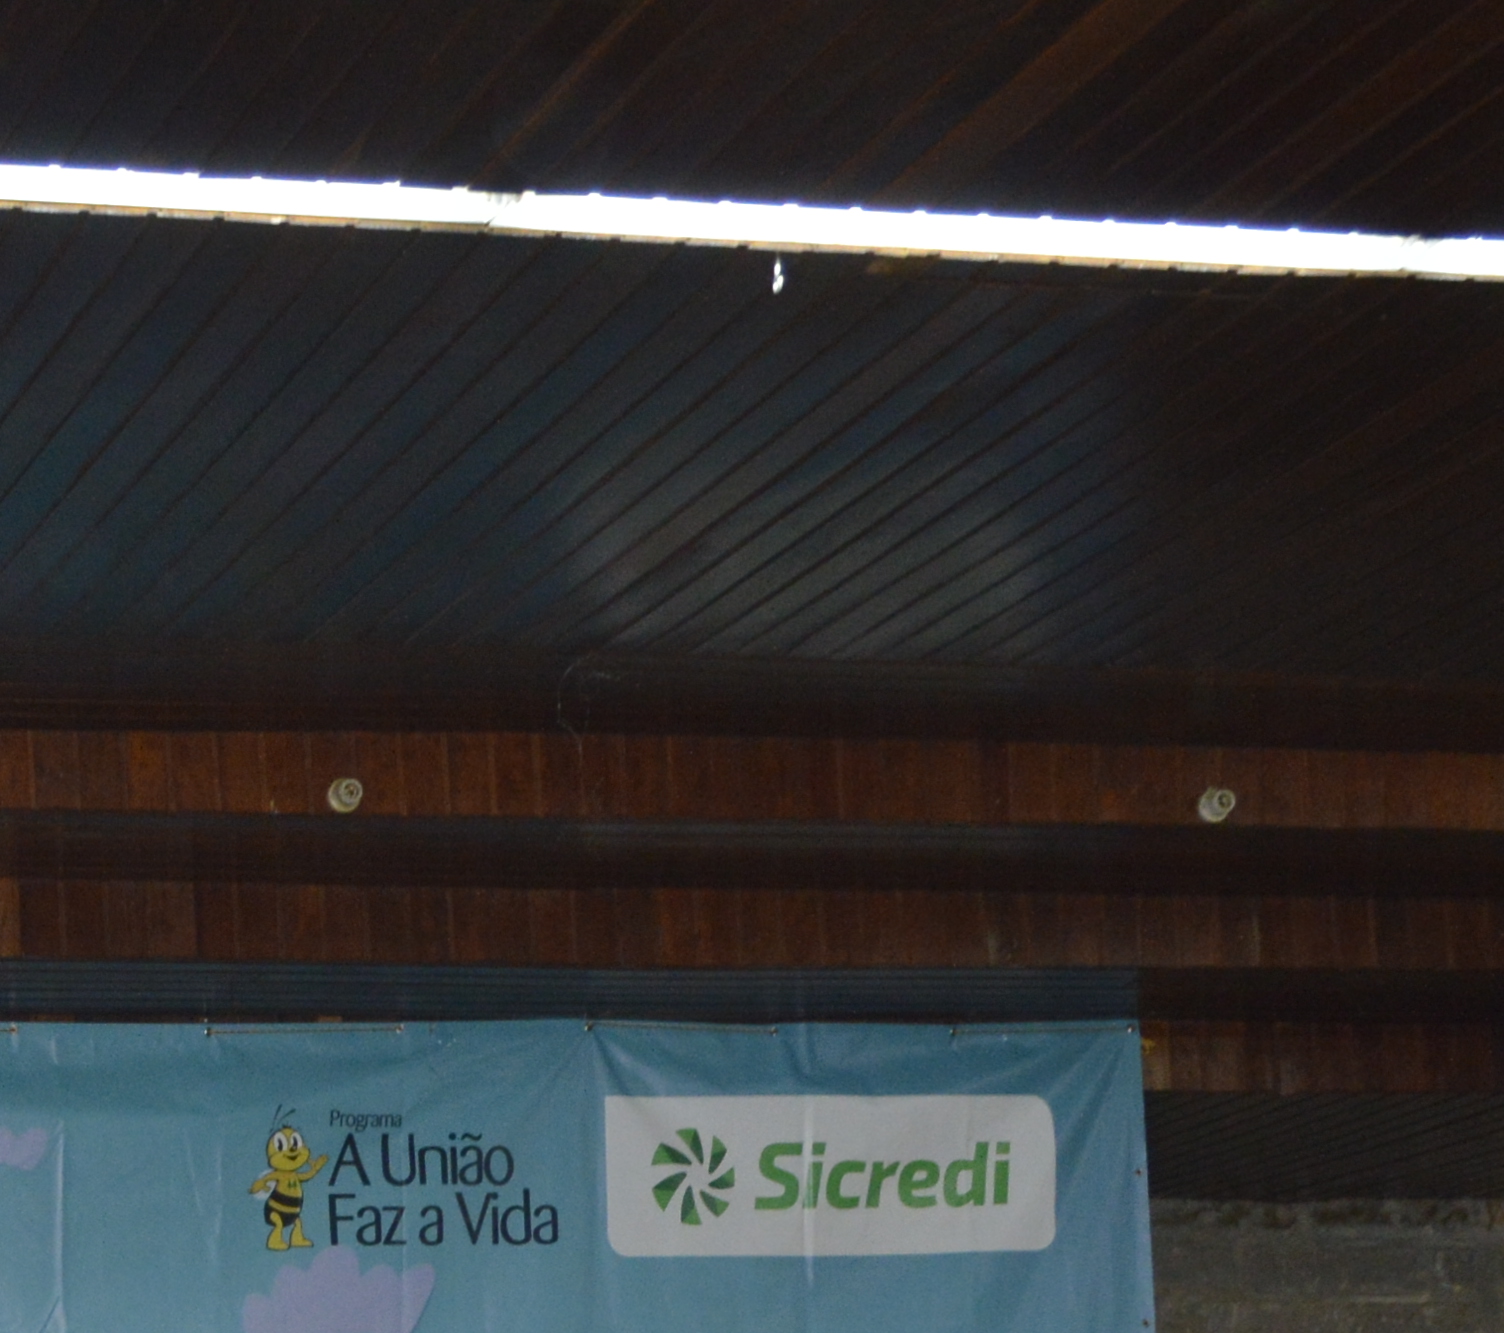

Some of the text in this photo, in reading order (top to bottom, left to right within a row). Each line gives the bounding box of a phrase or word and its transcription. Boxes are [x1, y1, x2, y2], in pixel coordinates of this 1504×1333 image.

[329, 1109, 403, 1132] Programa
[328, 1132, 515, 1187] A União
[753, 1140, 1012, 1211] Sicredi
[328, 1187, 560, 1246] Faz a Vida
